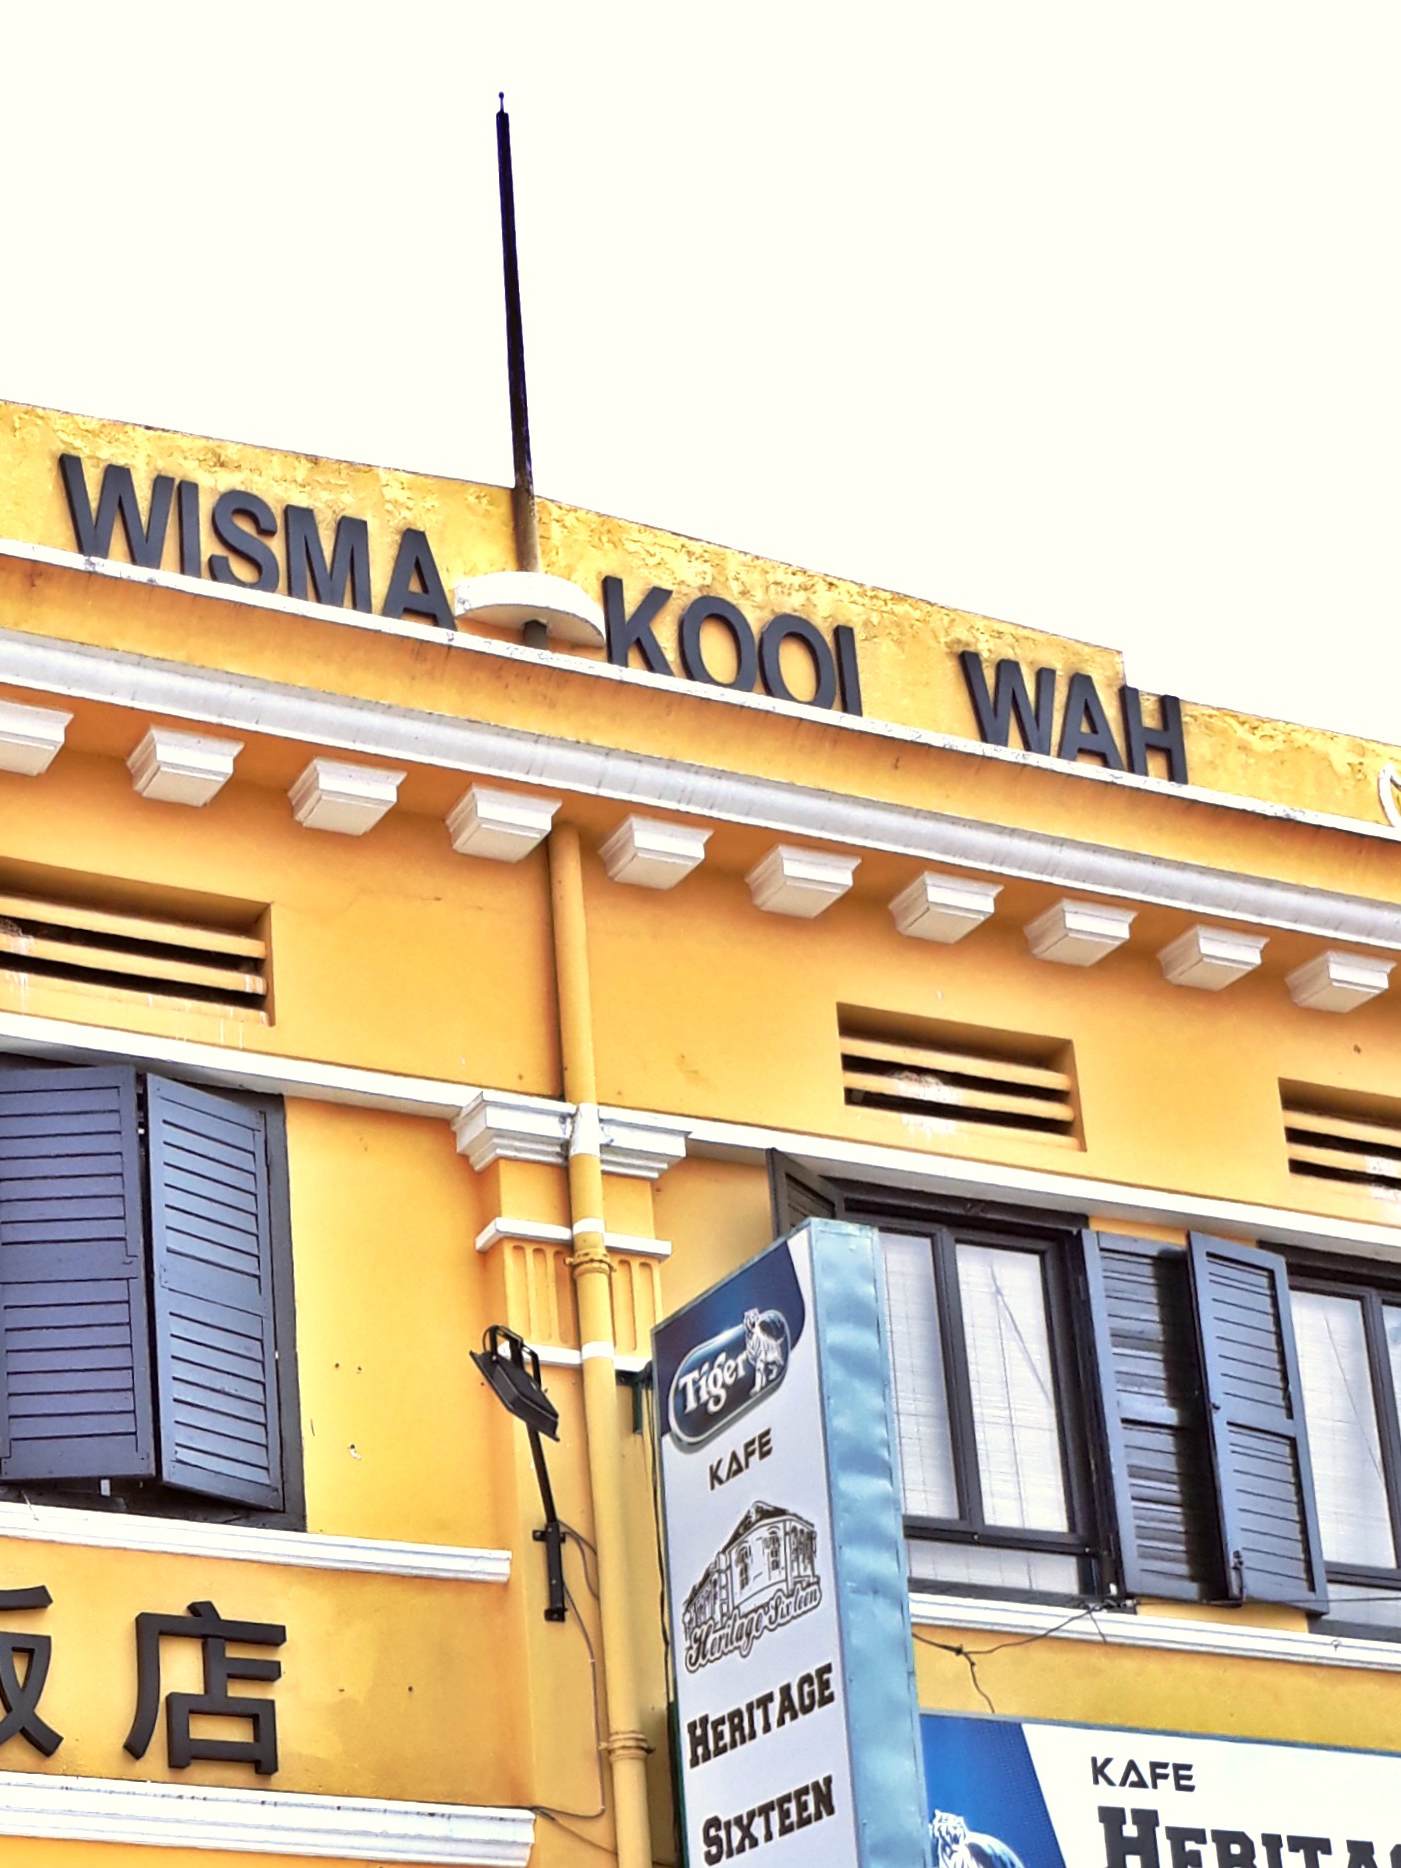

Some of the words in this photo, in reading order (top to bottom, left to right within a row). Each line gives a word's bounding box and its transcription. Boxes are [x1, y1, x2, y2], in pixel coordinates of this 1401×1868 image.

[58, 453, 457, 632] WISMA
[603, 574, 864, 718] KOOI
[959, 650, 1189, 784] WAH
[678, 1352, 748, 1415] Tiger
[708, 1427, 774, 1492] KAFE
[687, 1609, 764, 1670] Heritage
[686, 1662, 836, 1770] HERITAGE
[1090, 1755, 1196, 1793] KAFE
[701, 1773, 836, 1867] SIXTEEN
